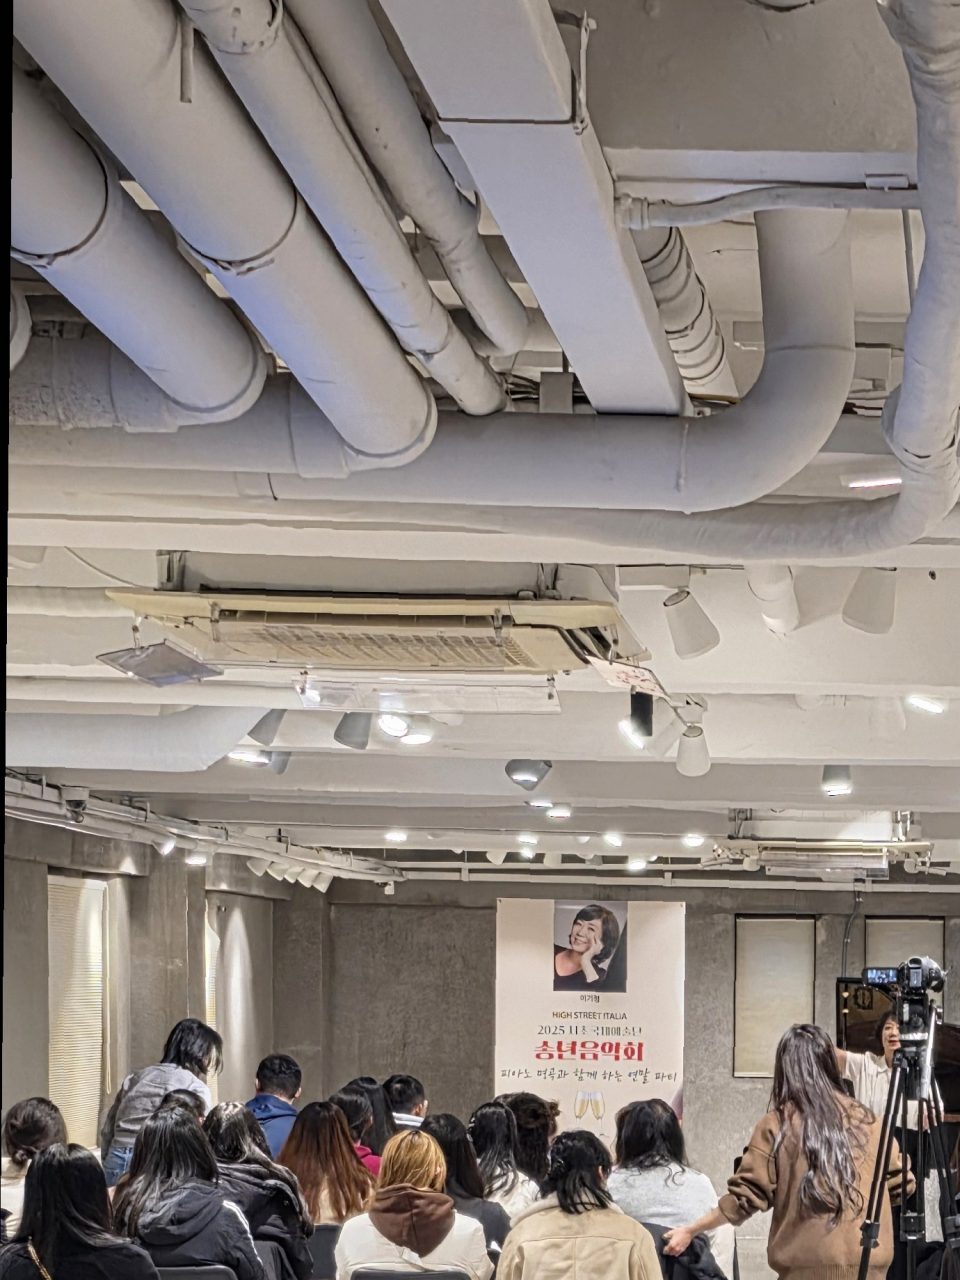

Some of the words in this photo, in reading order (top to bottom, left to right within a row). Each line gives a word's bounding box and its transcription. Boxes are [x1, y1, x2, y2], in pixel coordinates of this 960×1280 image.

[552, 1011, 573, 1019] HIGH
[573, 1011, 601, 1020] STREET
[603, 1012, 627, 1020] ITALIA
[538, 1025, 565, 1035] 2025
[534, 1040, 644, 1062] 송년음악회
[500, 1068, 532, 1079] 피아노
[536, 1067, 569, 1081] 명곡과
[573, 1068, 598, 1082] 함께
[602, 1068, 623, 1083] 하는
[627, 1067, 650, 1084] 연말
[655, 1072, 677, 1082] 파티
